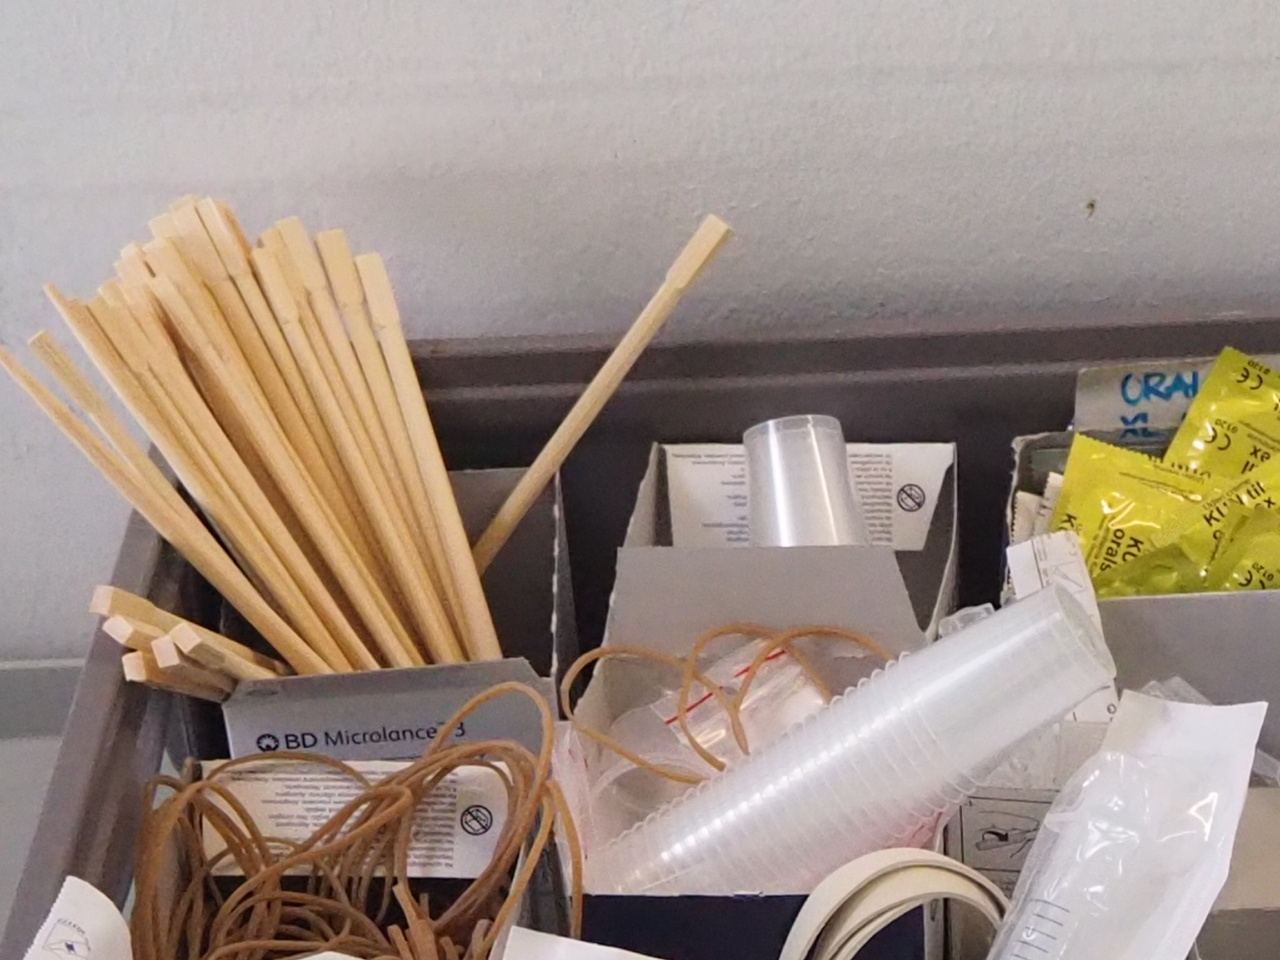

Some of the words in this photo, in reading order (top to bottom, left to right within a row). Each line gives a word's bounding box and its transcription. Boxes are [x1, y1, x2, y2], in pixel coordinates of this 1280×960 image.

[1099, 528, 1126, 572] orals
[1121, 535, 1145, 562] KU
[285, 733, 317, 751] BD
[323, 725, 437, 747] Microlance
